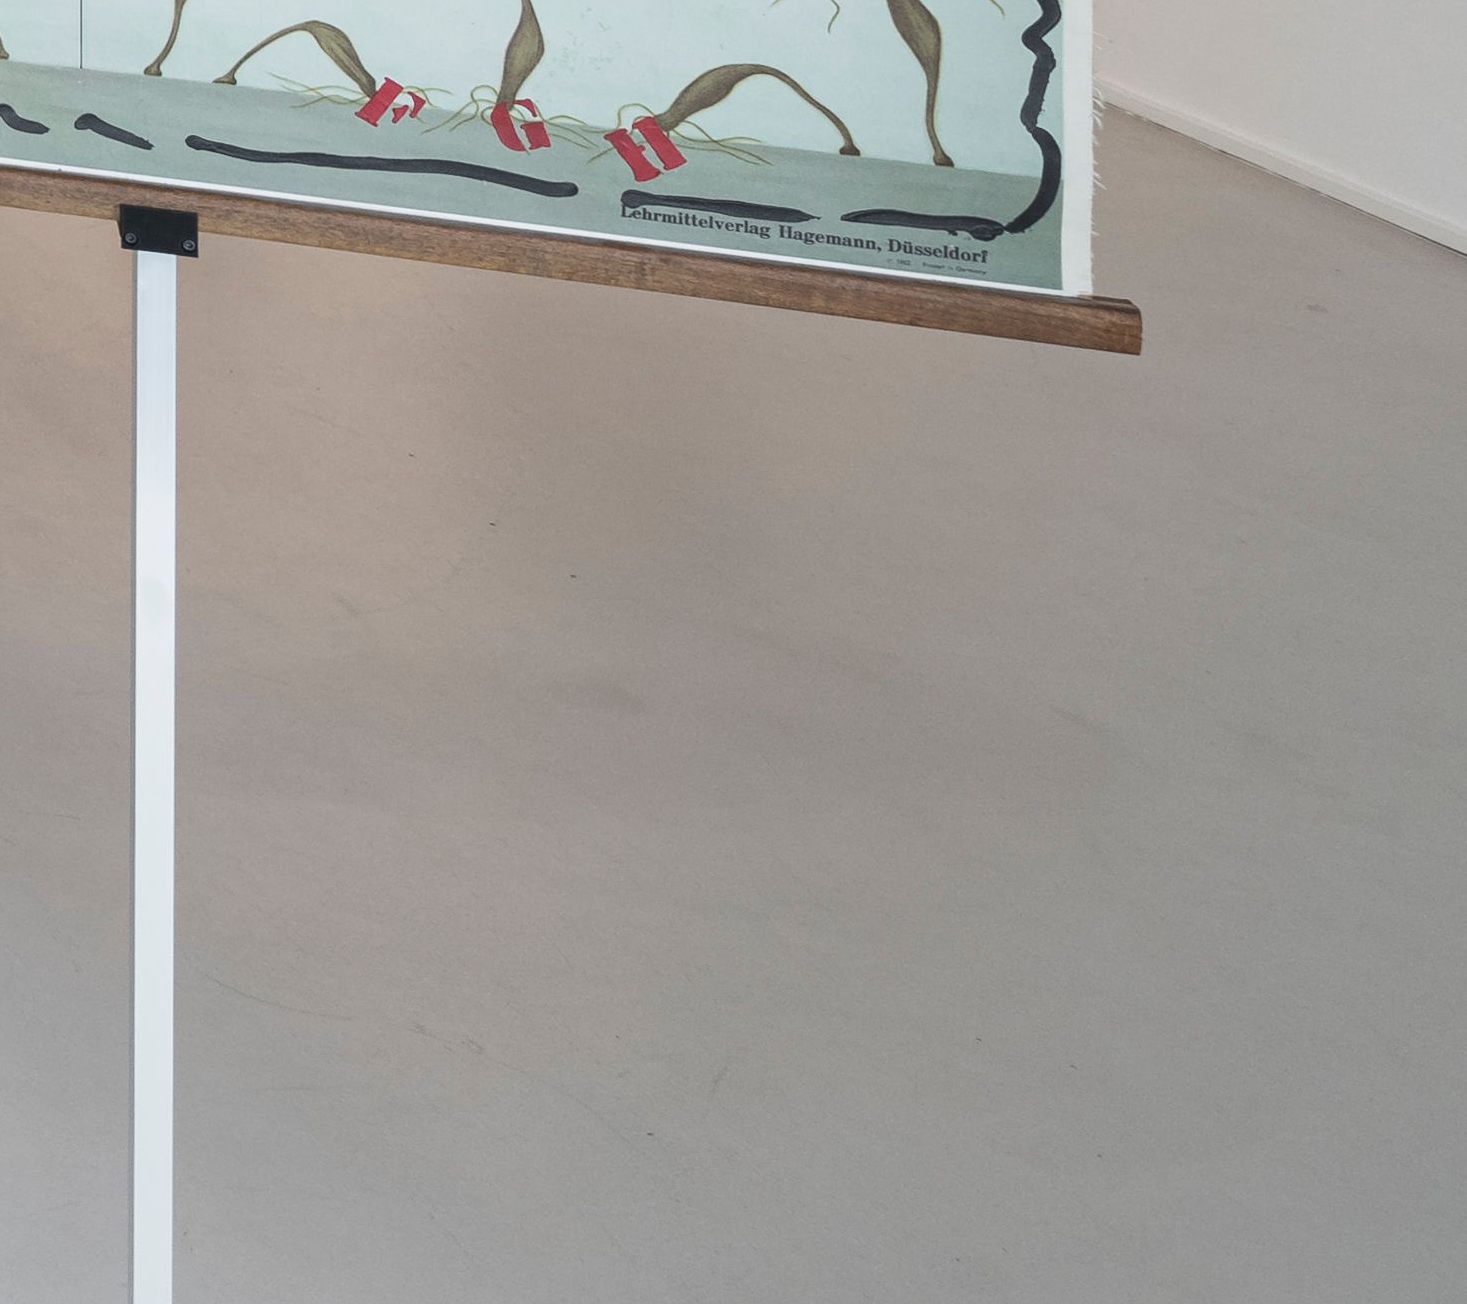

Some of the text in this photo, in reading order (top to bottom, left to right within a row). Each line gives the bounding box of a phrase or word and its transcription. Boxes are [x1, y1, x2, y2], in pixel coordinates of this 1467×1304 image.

[621, 203, 988, 264] Lehrmittelverlag Hagemann, Düsseldorf
